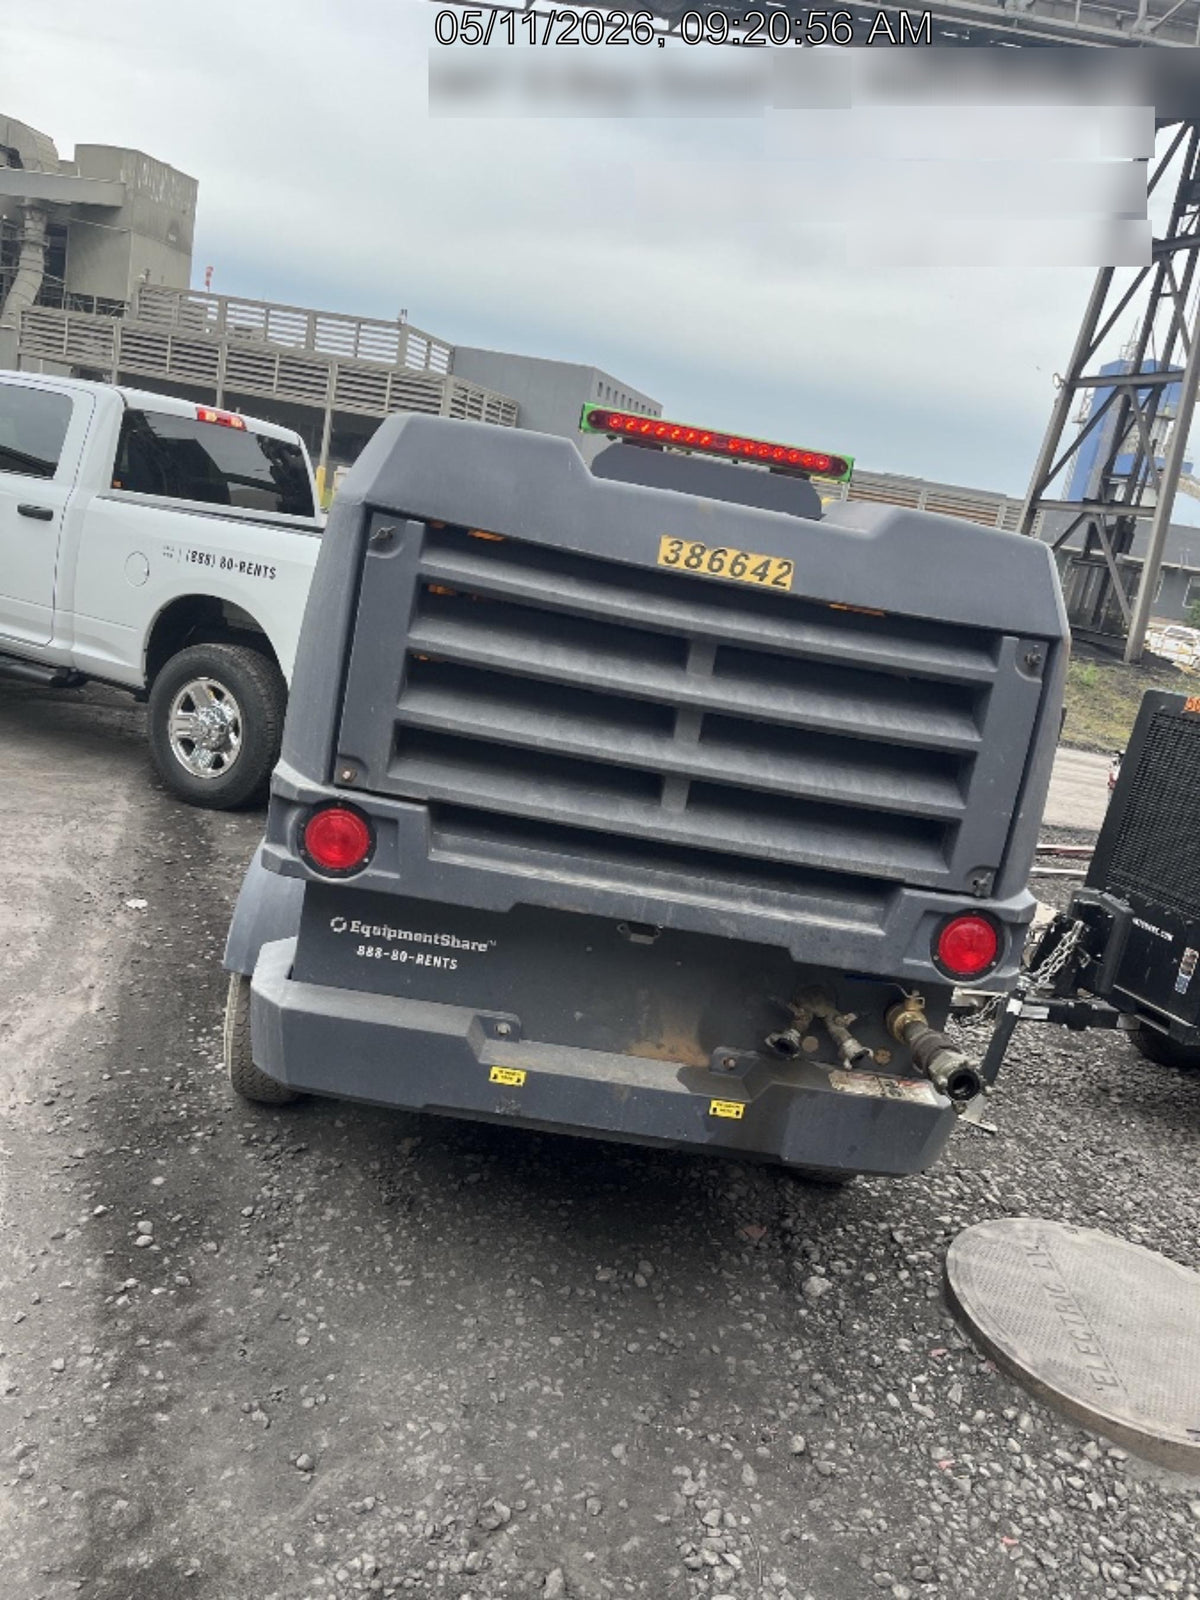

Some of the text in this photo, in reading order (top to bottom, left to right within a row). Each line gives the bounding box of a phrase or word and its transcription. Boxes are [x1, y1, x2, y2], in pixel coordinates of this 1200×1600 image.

[219, 556, 277, 580] 80-RENTS
[663, 539, 792, 587] 386642
[357, 945, 458, 970] 888-80-RENTS
[1043, 1283, 1119, 1388] ELECTRIC
